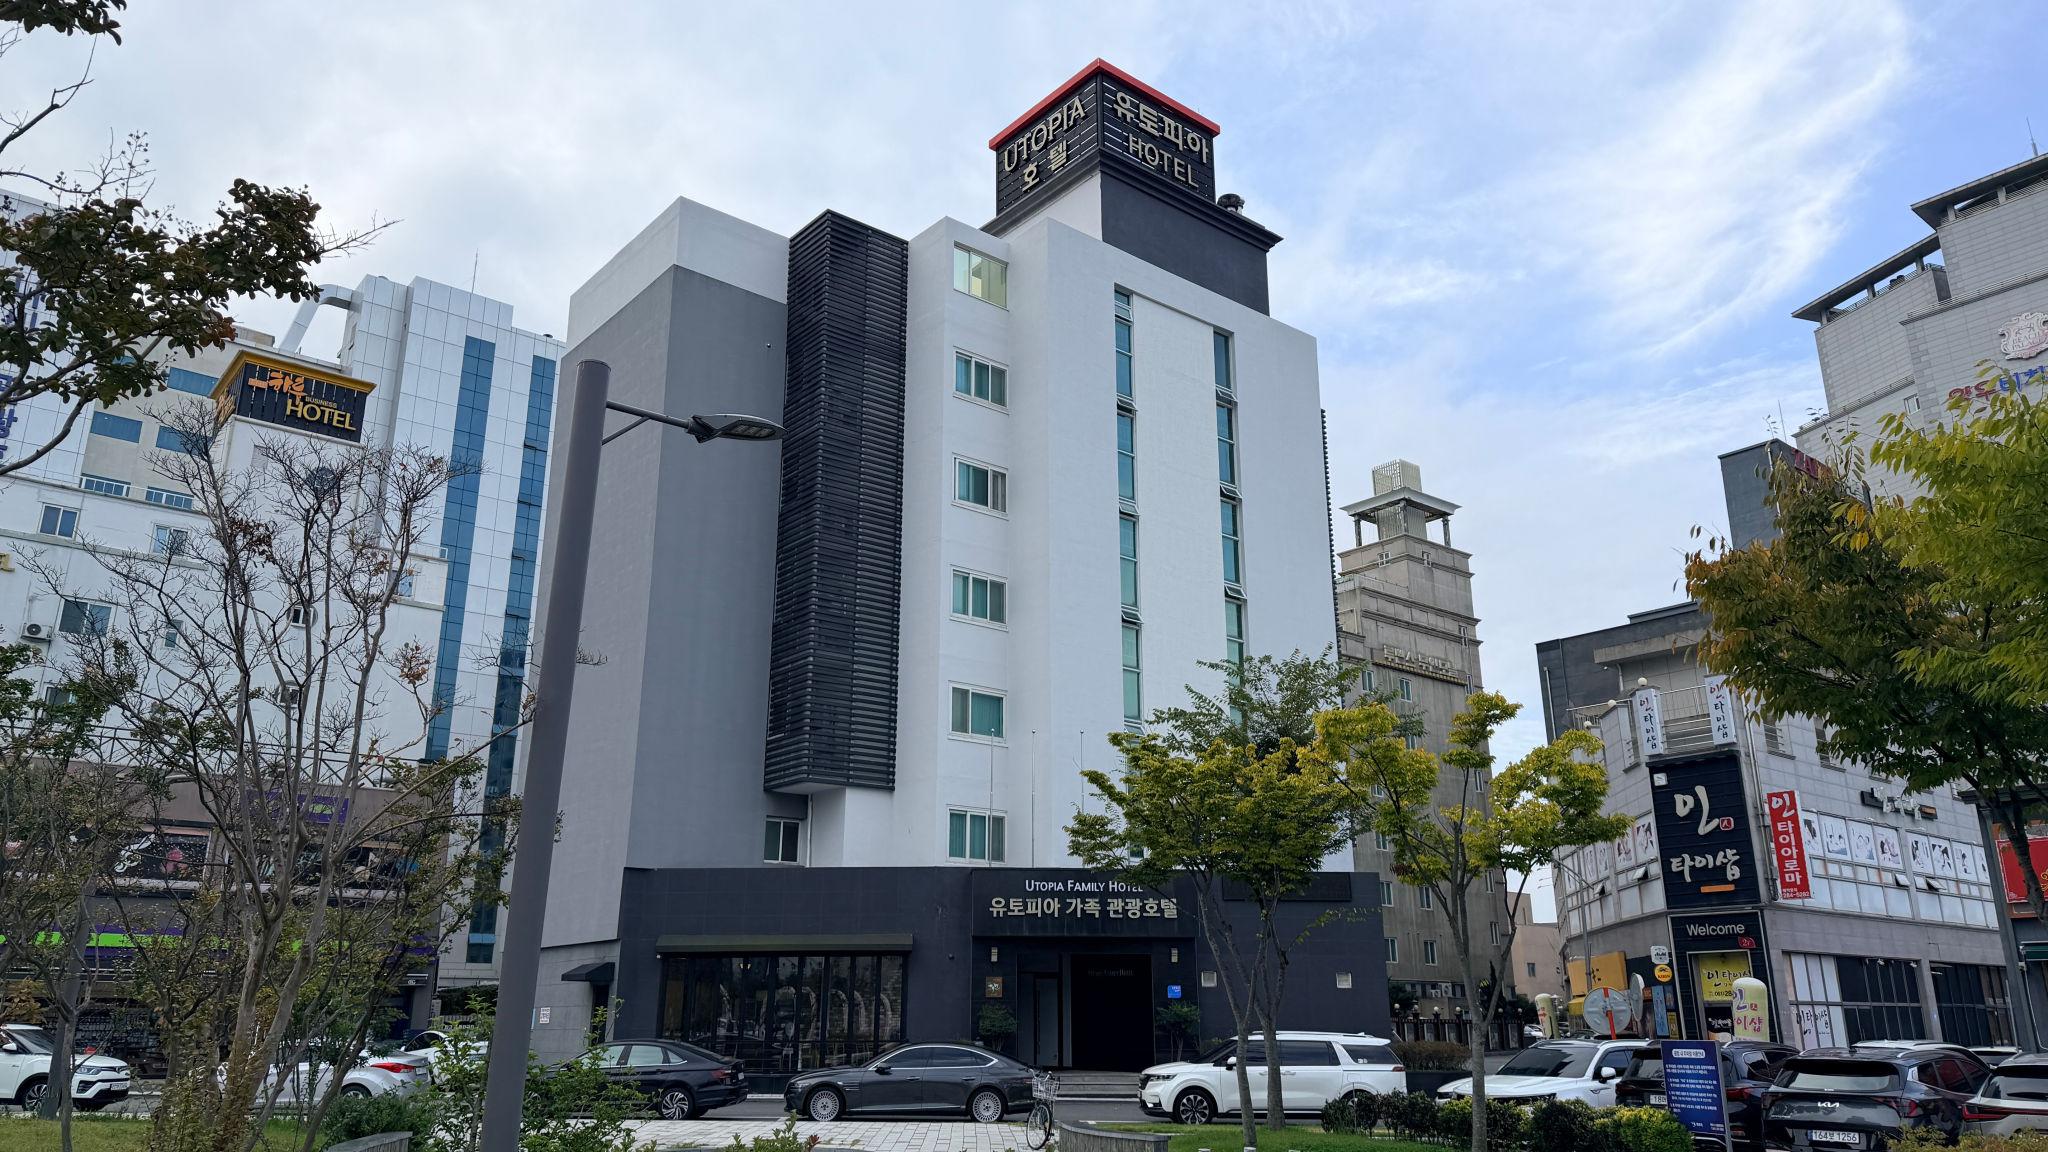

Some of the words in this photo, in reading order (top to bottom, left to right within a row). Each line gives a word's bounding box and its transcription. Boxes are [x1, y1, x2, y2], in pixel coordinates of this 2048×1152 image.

[1003, 95, 1085, 172] UTOPIA
[1113, 91, 1209, 164] 유토피아
[1128, 133, 1199, 188] HOTEL
[286, 399, 357, 431] HOTEL
[305, 395, 338, 408] BUSINESS
[1673, 785, 1720, 836] 민
[1771, 793, 1795, 818] 민
[1776, 820, 1802, 886] 타이아로마
[1025, 879, 1065, 892] UTOPIA
[1067, 879, 1106, 892] FAMILY
[989, 897, 1061, 918] 유토피아
[1065, 897, 1102, 918] 가족
[1106, 897, 1178, 919] 관광호텔
[1686, 923, 1745, 936] Welcome
[1837, 1132, 1858, 1142] 1256
